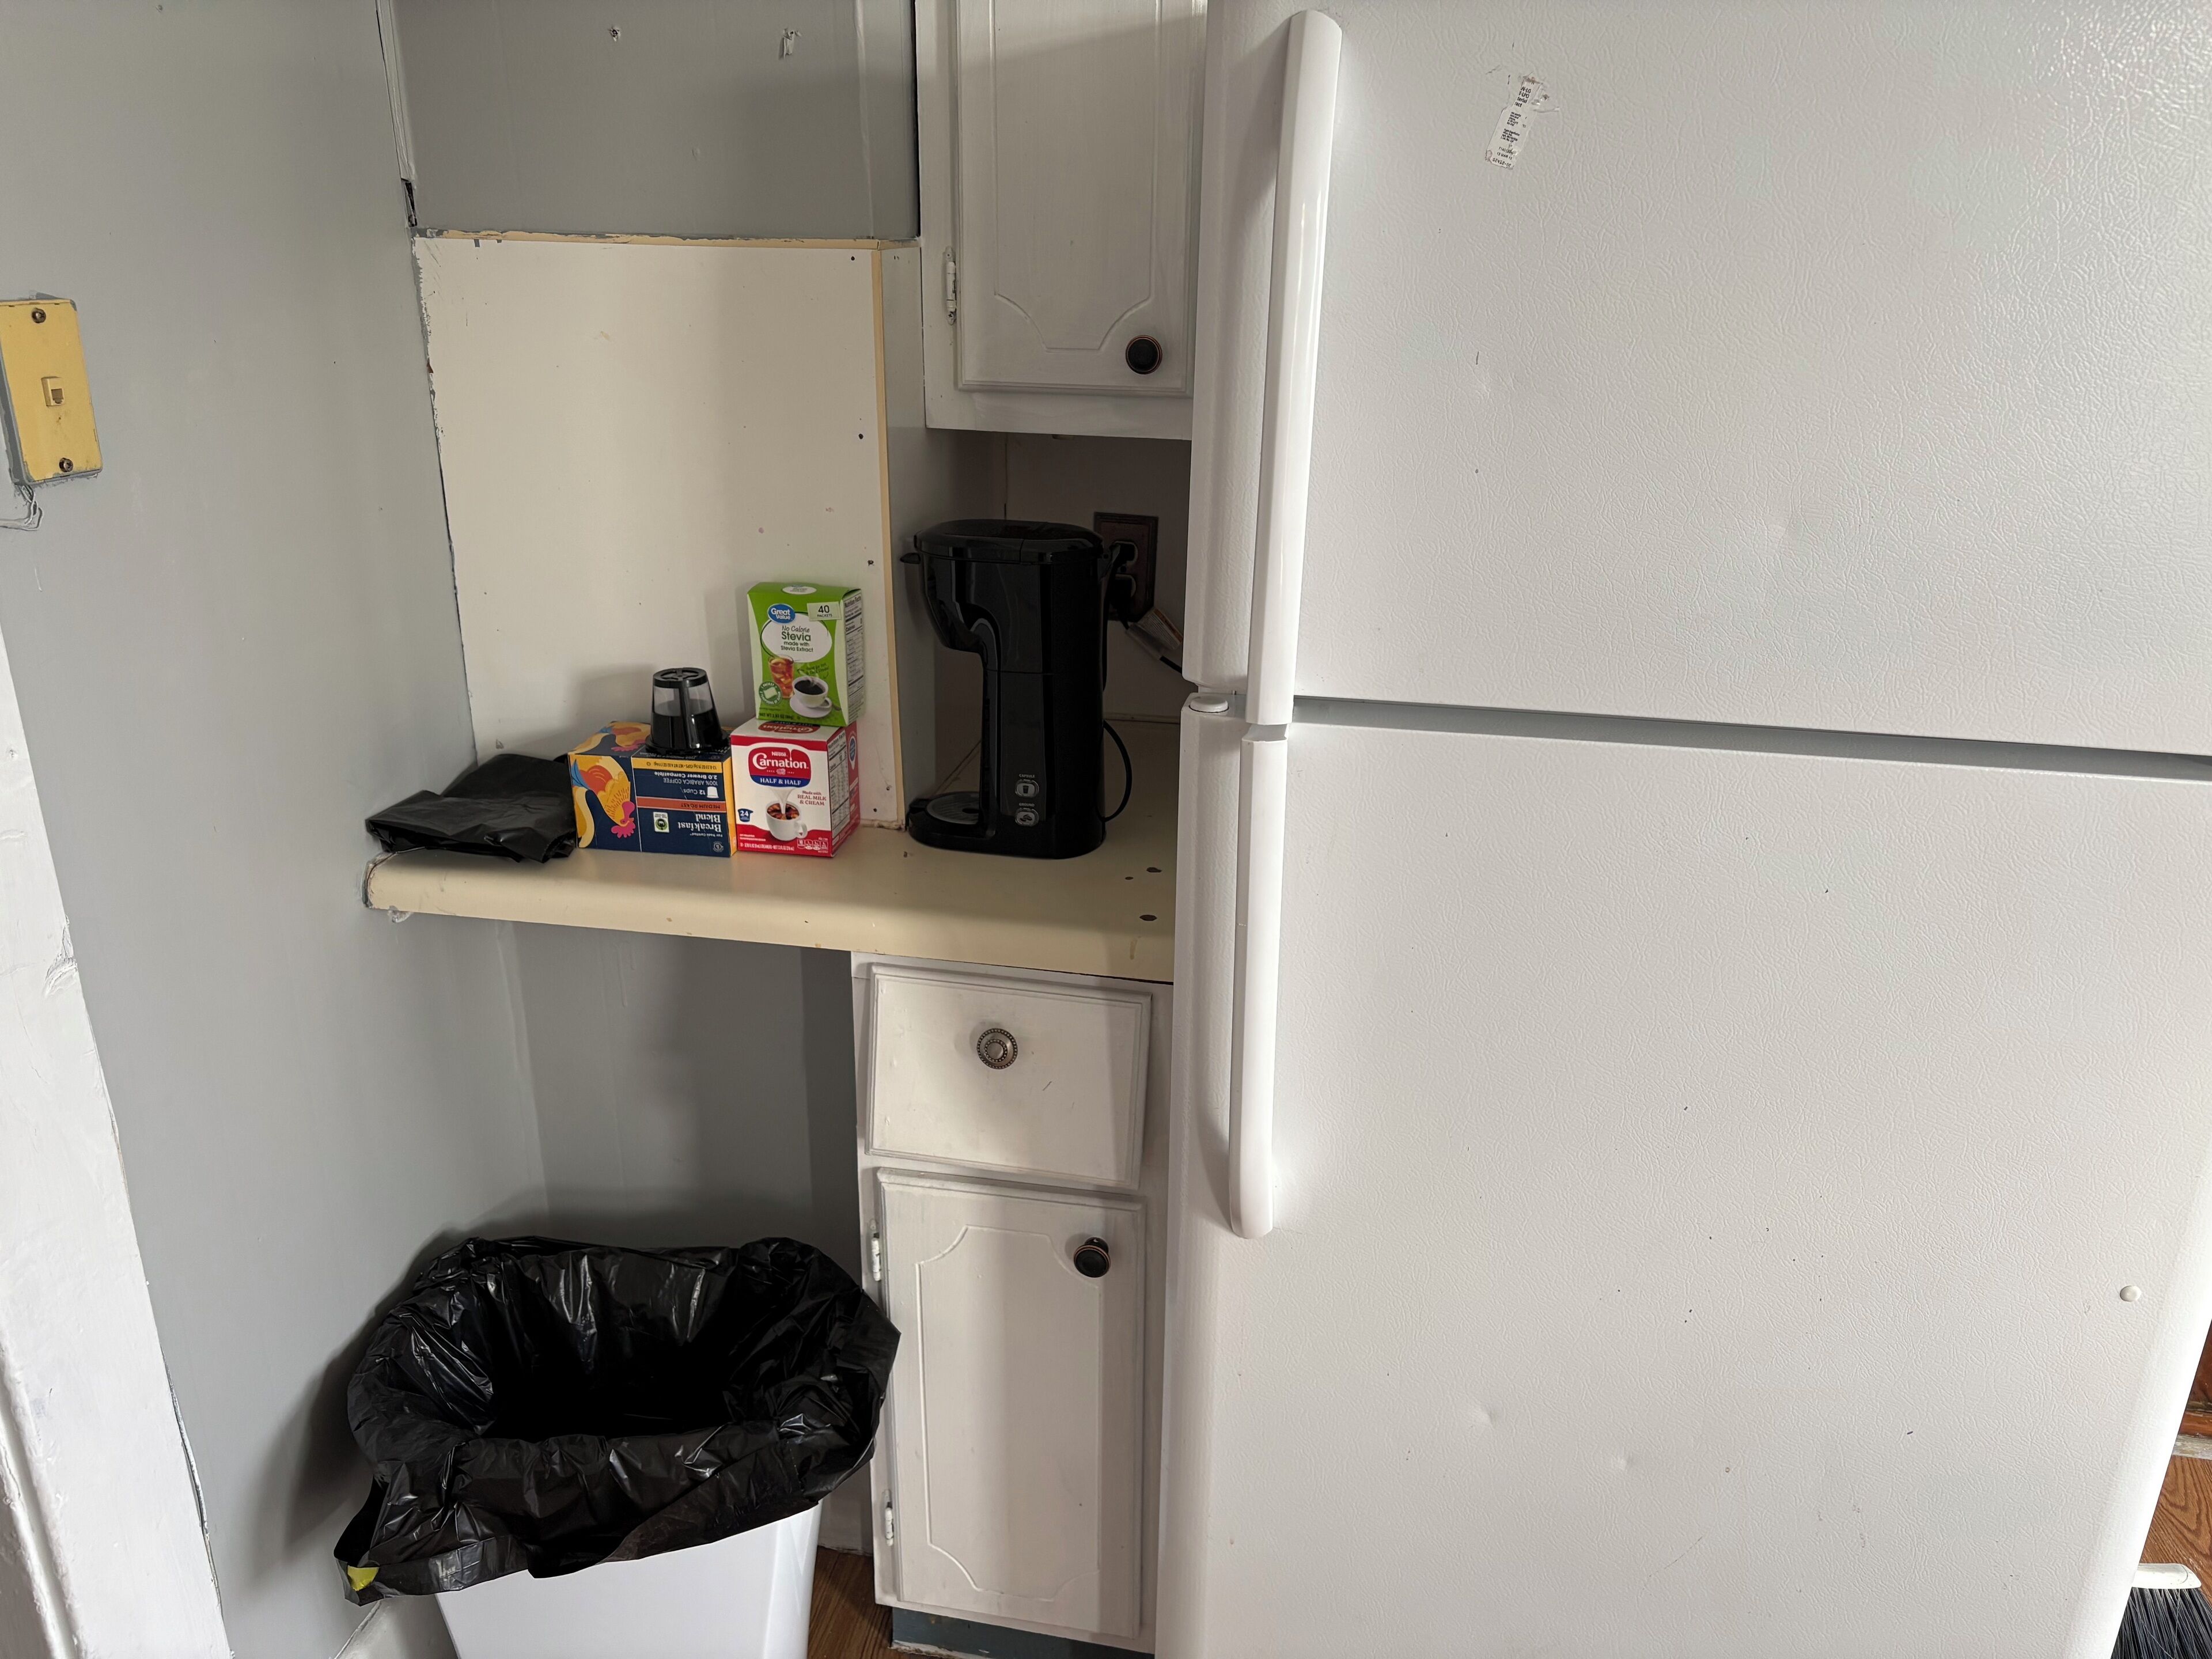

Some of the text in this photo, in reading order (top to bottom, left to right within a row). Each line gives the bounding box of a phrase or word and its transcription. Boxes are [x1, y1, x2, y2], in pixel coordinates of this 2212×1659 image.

[818, 605, 830, 613] 40
[781, 631, 811, 642] Stevia
[752, 752, 807, 770] Carnation
[695, 813, 721, 823] Blend
[677, 821, 721, 832] Breakfast
